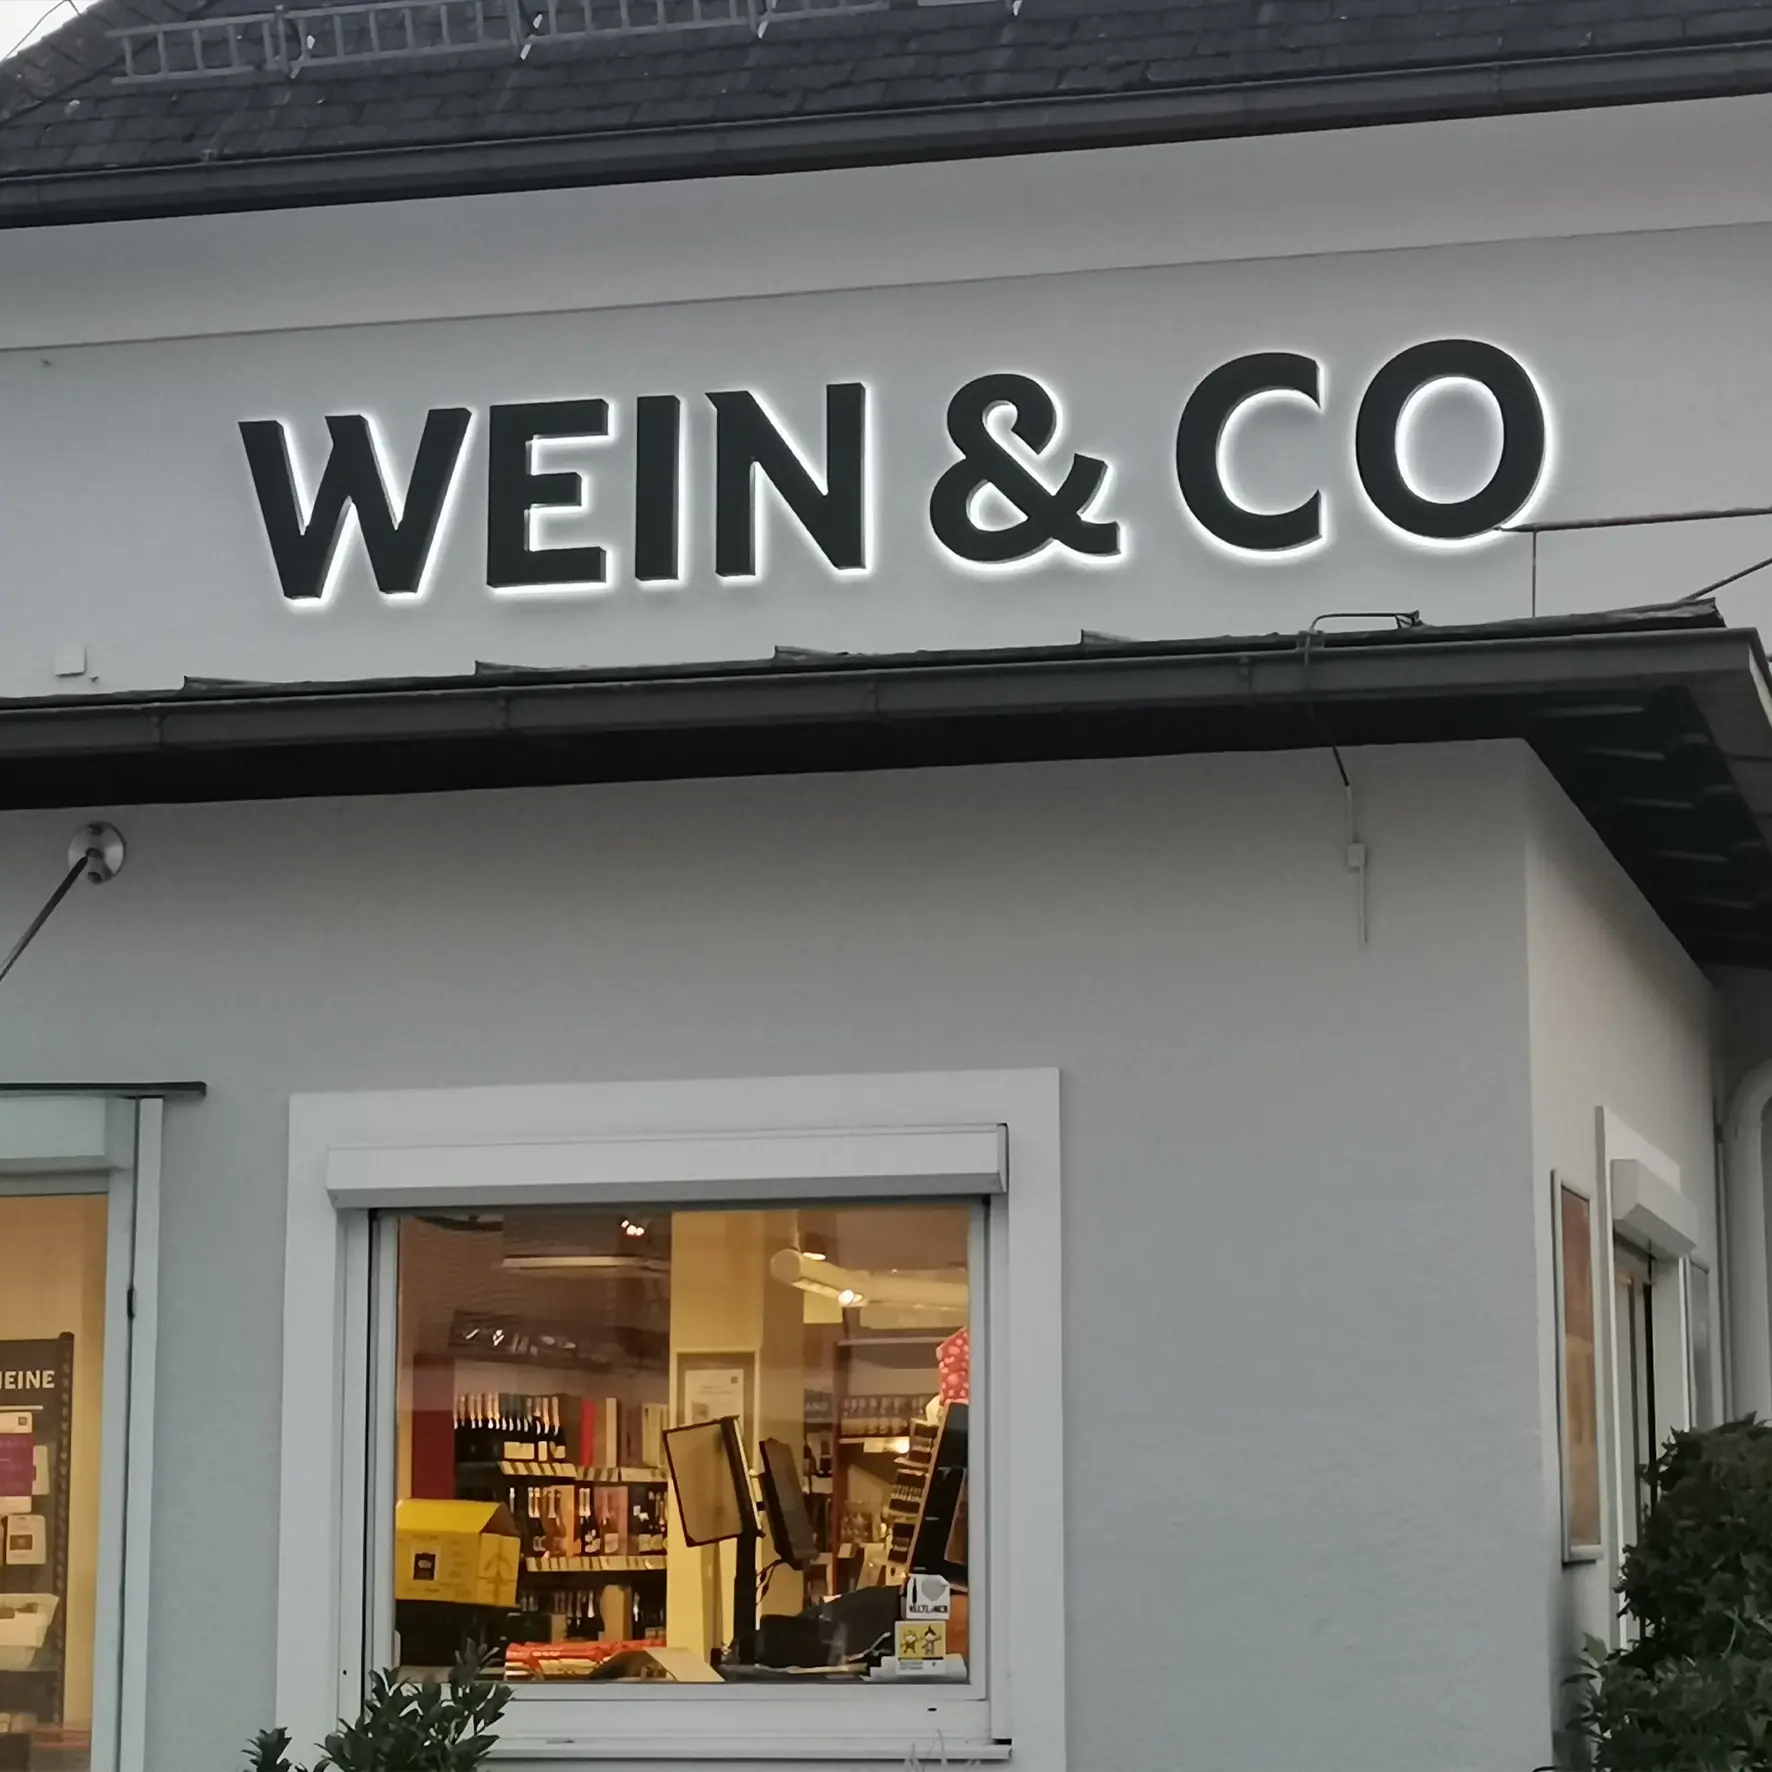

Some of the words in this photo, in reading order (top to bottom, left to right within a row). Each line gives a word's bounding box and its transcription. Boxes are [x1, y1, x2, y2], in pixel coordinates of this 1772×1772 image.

[238, 382, 866, 600] WEIN
[929, 373, 1121, 563] &
[1175, 339, 1547, 552] CO
[0, 1369, 56, 1390] EINE
